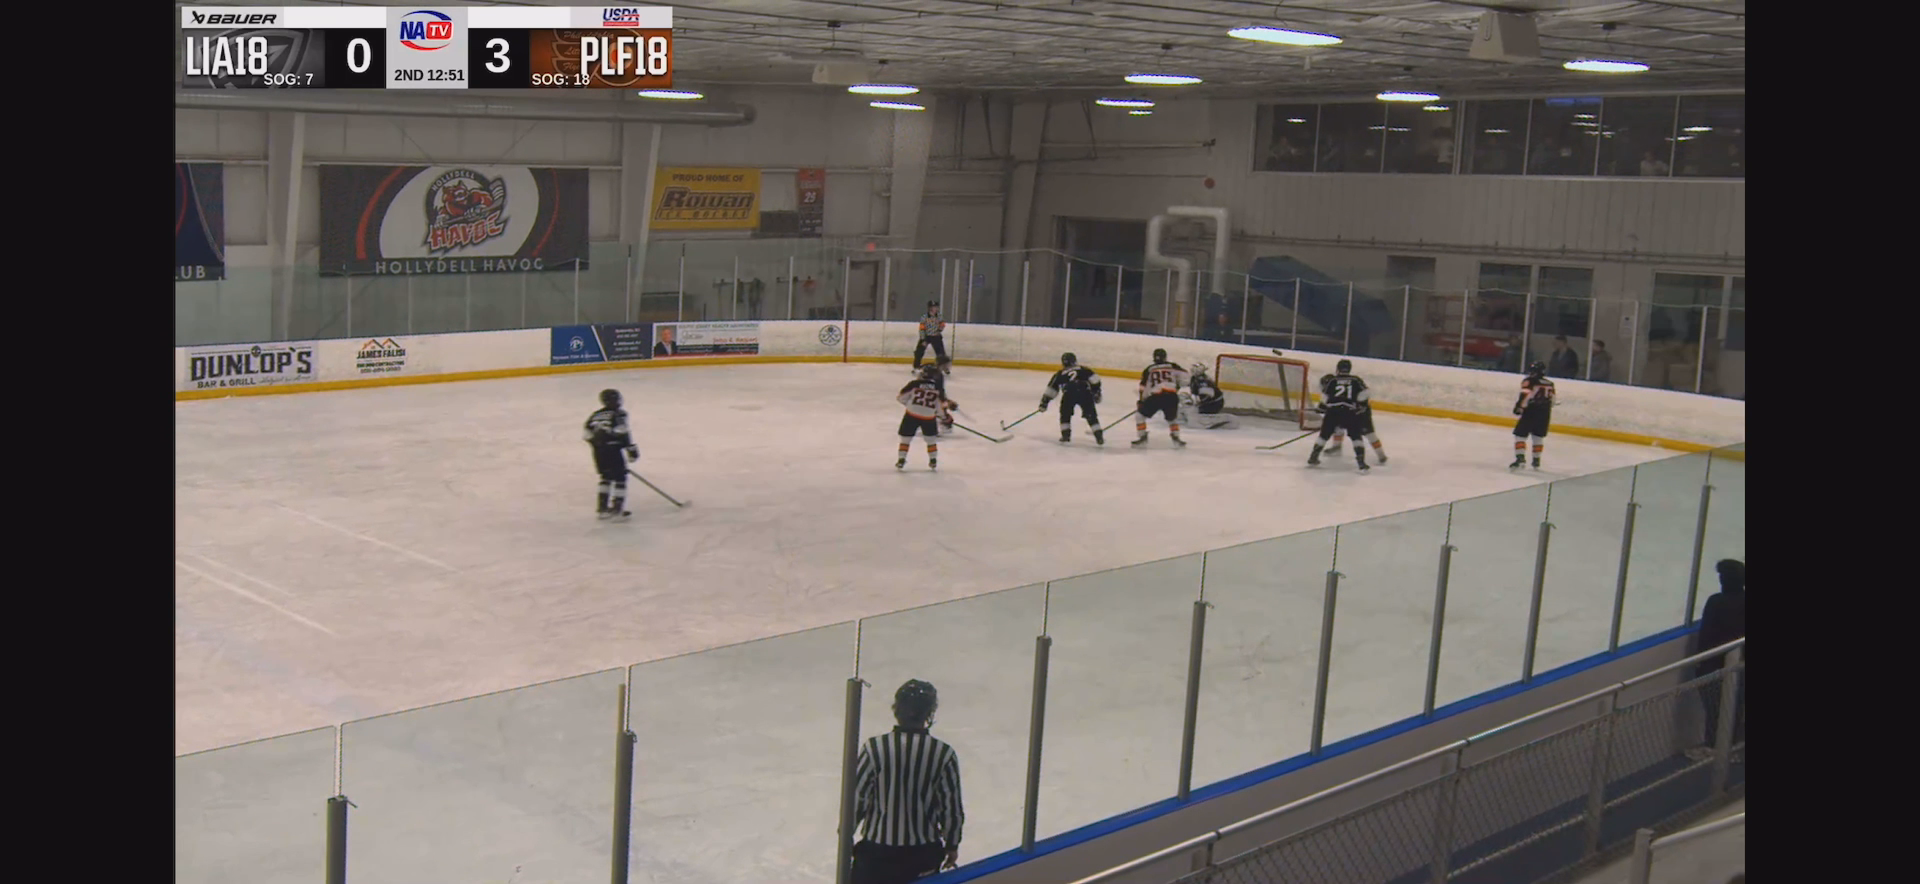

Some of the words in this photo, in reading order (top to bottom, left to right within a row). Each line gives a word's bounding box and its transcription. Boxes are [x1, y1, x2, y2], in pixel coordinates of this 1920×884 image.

[431, 170, 476, 192] HOLLYDELL
[672, 173, 704, 182] PROUD
[705, 174, 731, 182] HOME
[732, 174, 745, 182] OF
[662, 188, 754, 209] Rowan
[427, 209, 504, 251] HAVOC
[175, 266, 206, 279] UB
[375, 259, 477, 275] HOLLYDELL
[483, 257, 544, 272] HAVOC
[356, 350, 382, 359] JAMES
[197, 381, 216, 389] BAR
[219, 379, 226, 387] &
[229, 377, 256, 386] GRILL
[912, 389, 937, 409] 22
[1334, 385, 1353, 400] 21
